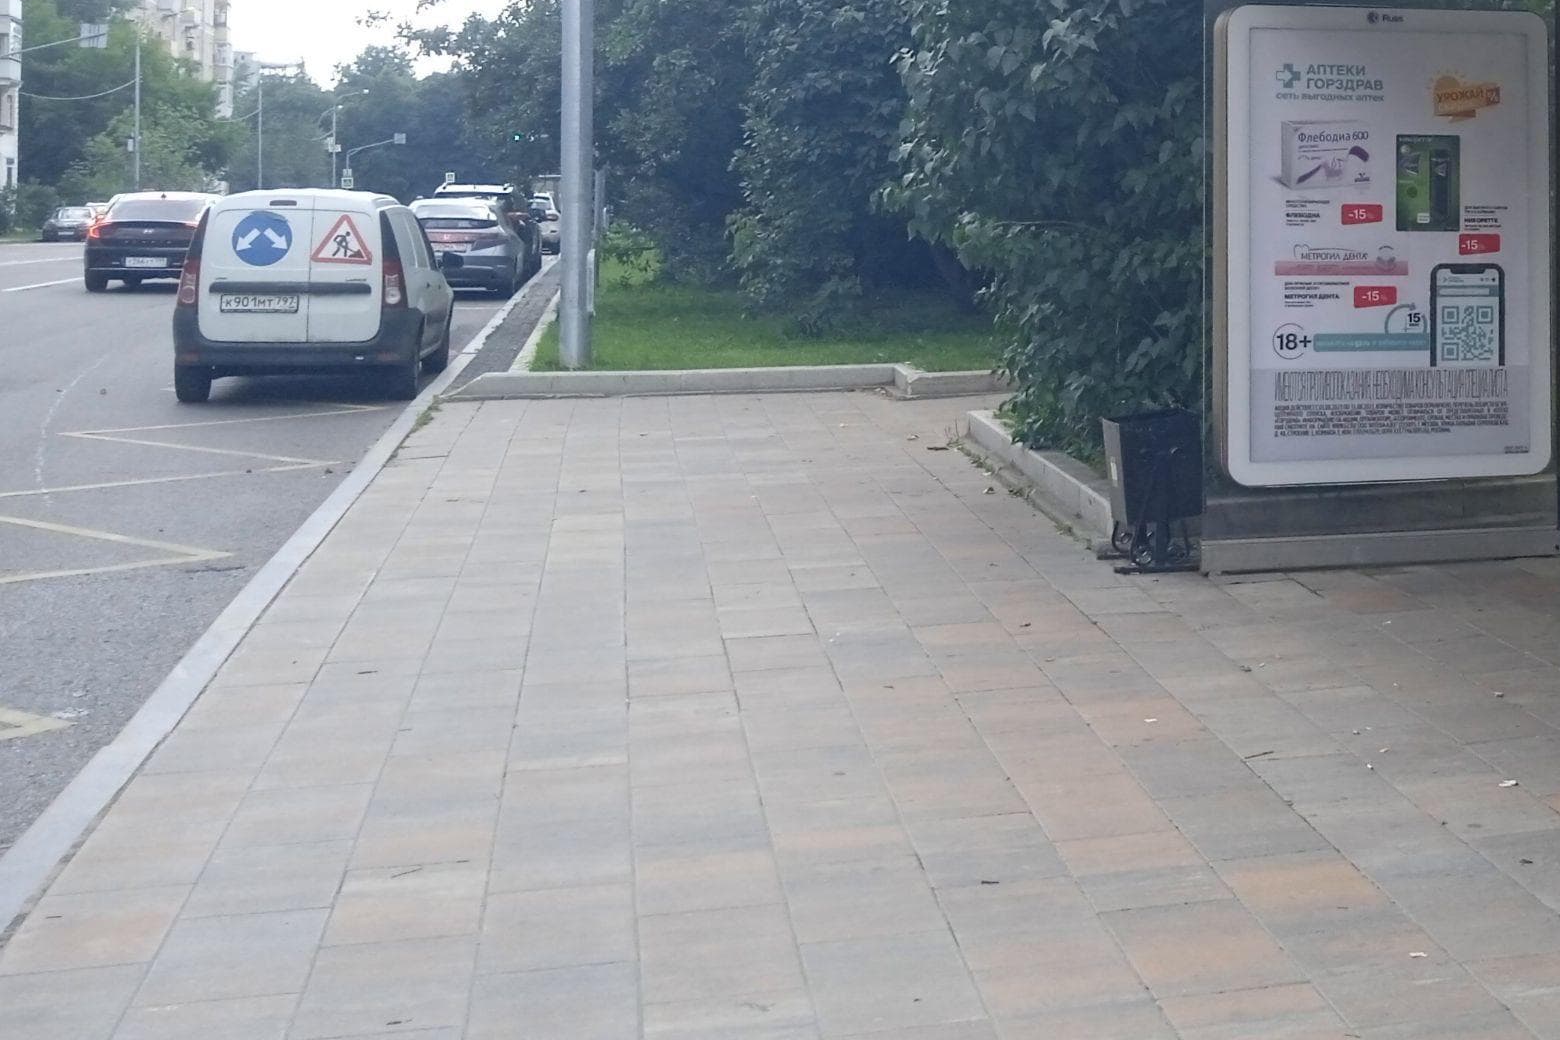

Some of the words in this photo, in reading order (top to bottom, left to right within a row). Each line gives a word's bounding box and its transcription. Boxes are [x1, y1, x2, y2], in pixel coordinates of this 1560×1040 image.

[1306, 64, 1366, 76] АПТЕКИ
[1306, 78, 1384, 91] ГОРЗДРАВ
[1275, 92, 1299, 100] сеть
[1301, 92, 1353, 101] выгодных
[1355, 93, 1385, 102] аптек
[1298, 131, 1350, 145] Флебодиа
[1352, 130, 1369, 141] 600
[1408, 312, 1421, 323] 15
[1276, 333, 1312, 351] 18+
